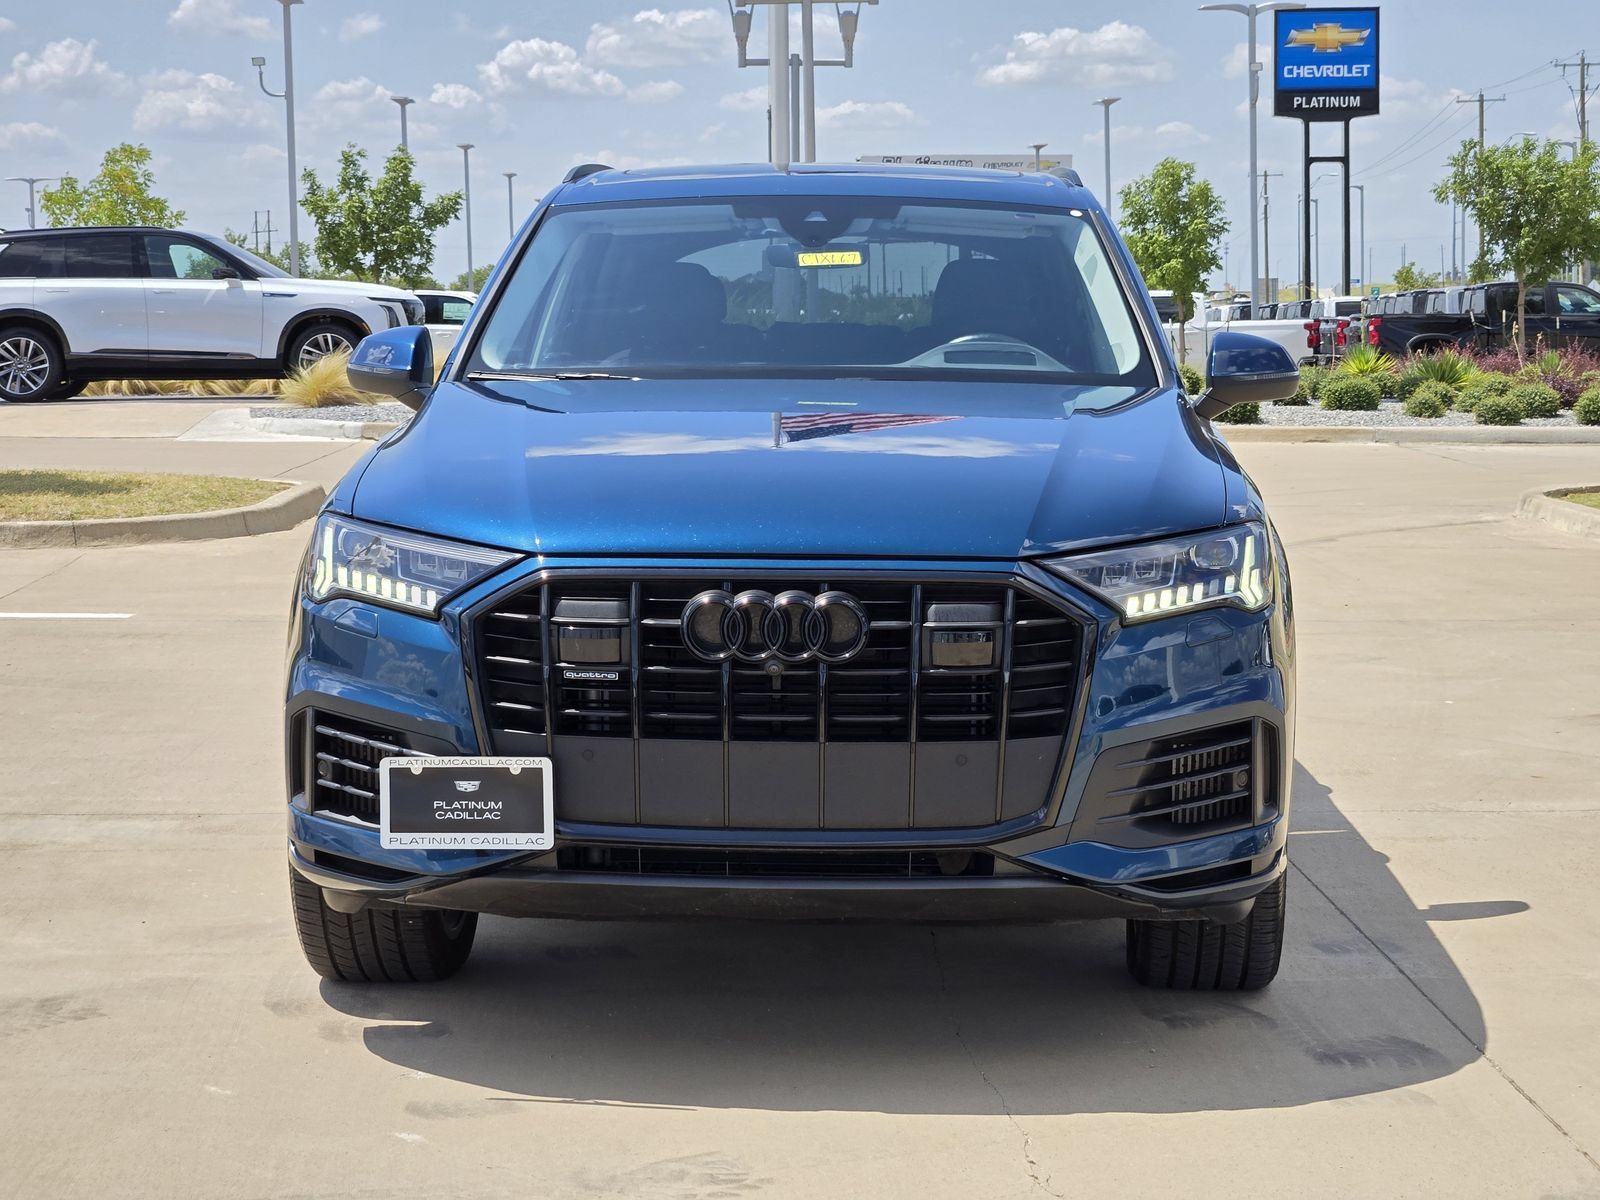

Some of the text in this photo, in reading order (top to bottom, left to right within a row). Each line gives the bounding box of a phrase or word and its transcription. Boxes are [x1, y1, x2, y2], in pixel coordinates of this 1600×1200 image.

[1283, 64, 1371, 78] CHEVROLET
[1293, 95, 1361, 108] PLATINUM
[565, 671, 616, 679] quattro
[389, 758, 543, 767] PLATINUMCADILLAC.COM
[433, 800, 503, 810] PLATINUM
[435, 811, 502, 820] CADILLAC
[389, 836, 546, 847] PLATINUM CADILLAC
